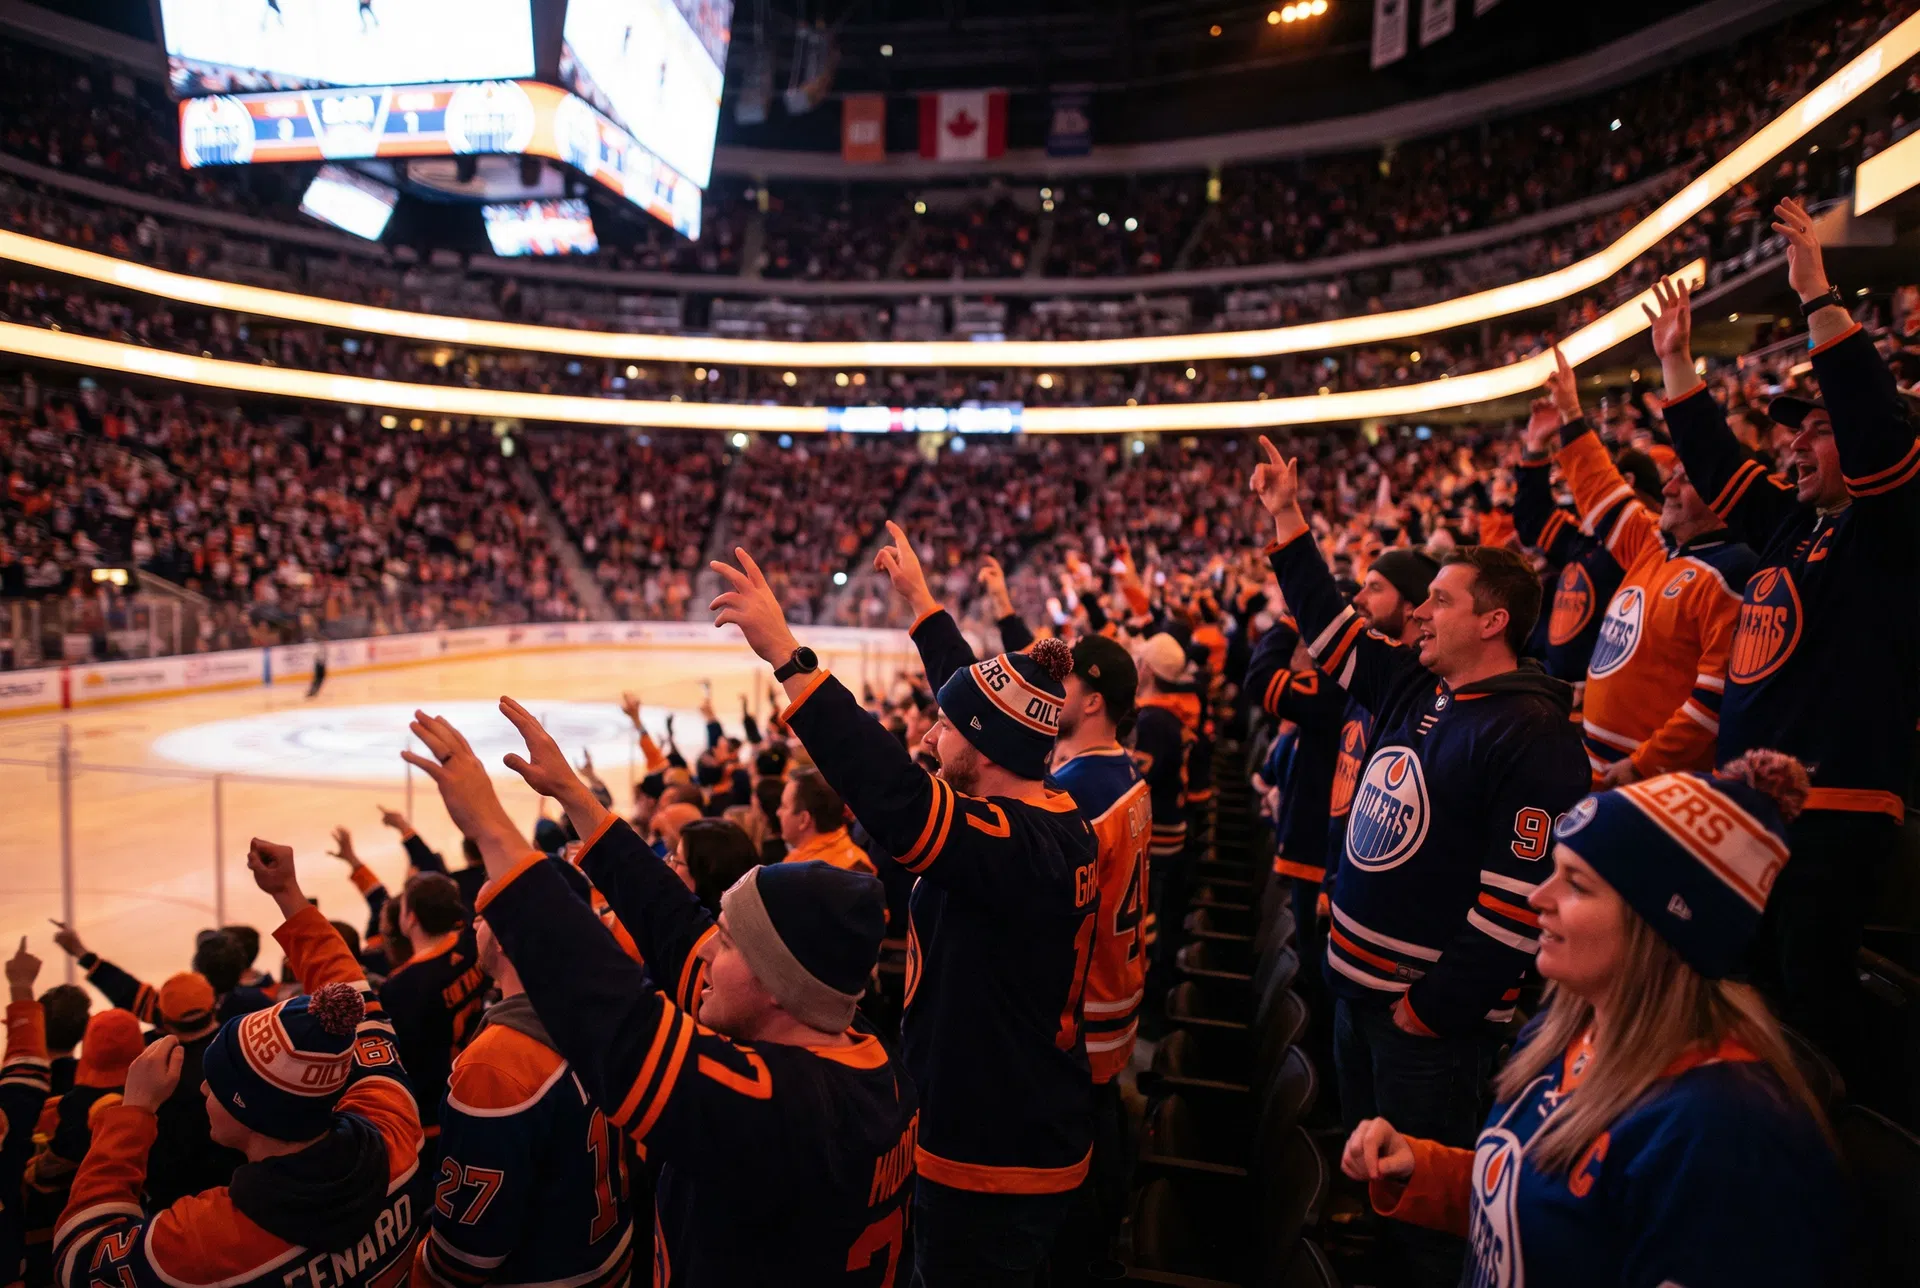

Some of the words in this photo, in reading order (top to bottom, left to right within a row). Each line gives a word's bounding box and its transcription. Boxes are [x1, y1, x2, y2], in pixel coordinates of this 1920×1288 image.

[1807, 527, 1835, 562] C
[1662, 567, 1697, 599] C
[978, 660, 1011, 692] ERS
[1358, 782, 1415, 836] OILERS
[1511, 806, 1565, 861] 9
[248, 1010, 282, 1066] ERS
[434, 1156, 504, 1226] 27
[1568, 1131, 1612, 1199] C
